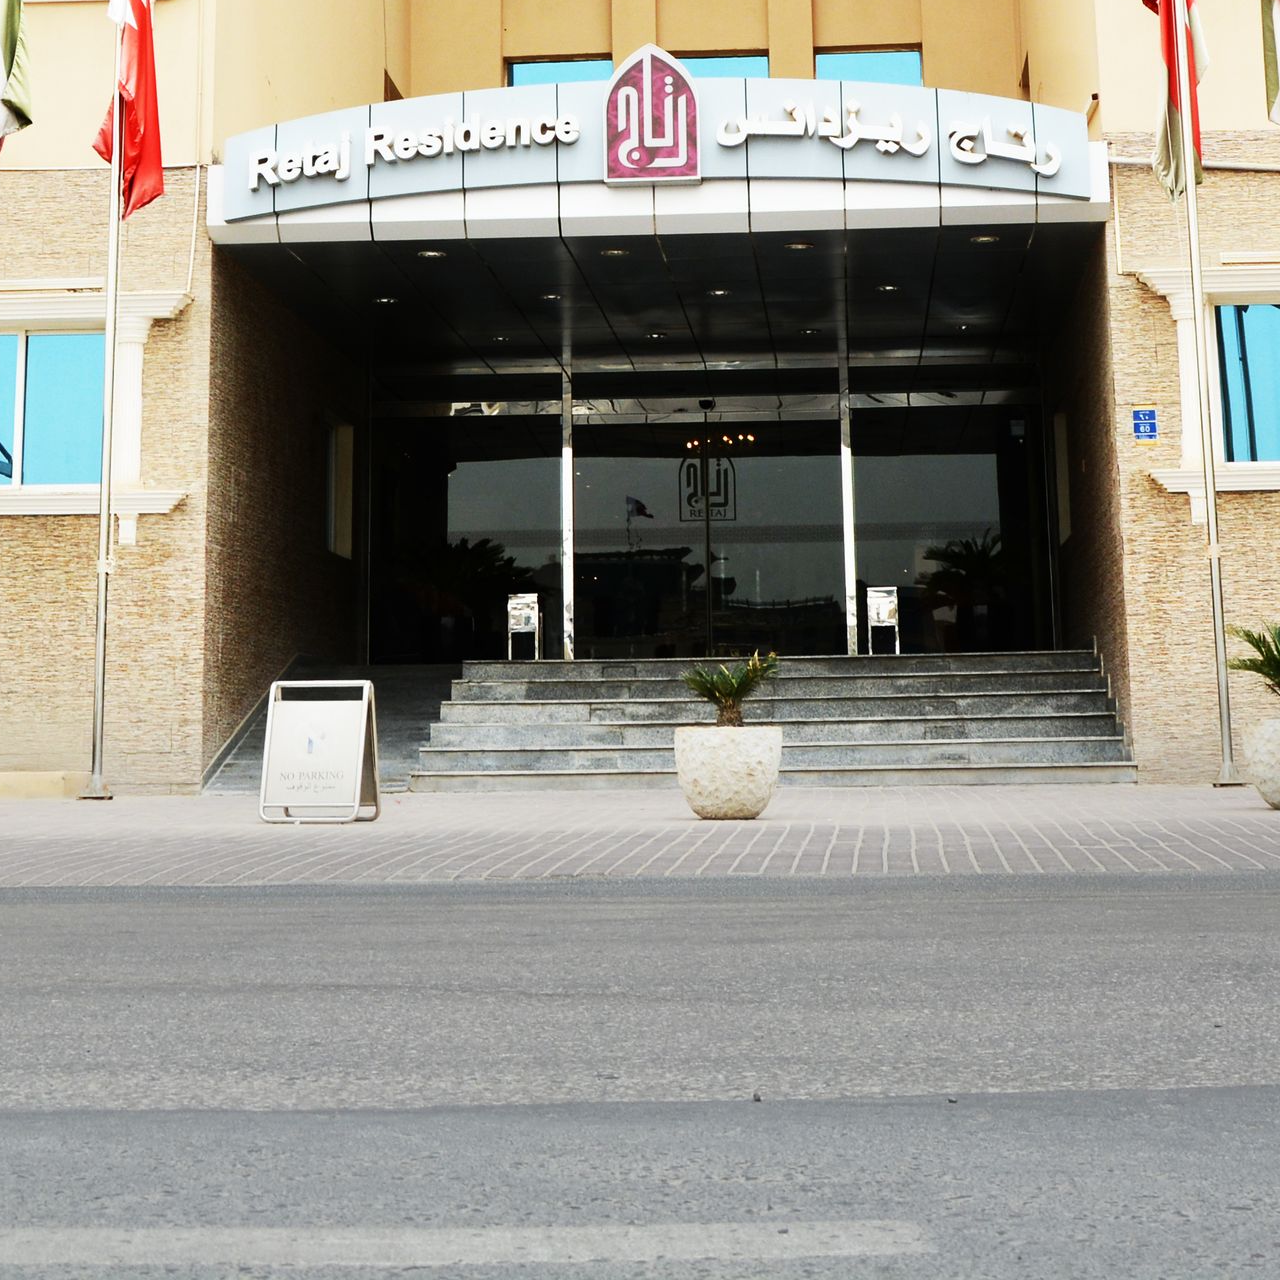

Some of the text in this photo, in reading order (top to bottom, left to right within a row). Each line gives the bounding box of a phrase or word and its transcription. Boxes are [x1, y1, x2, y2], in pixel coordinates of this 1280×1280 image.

[248, 113, 581, 192] Retaj Residence
[948, 115, 1062, 179] رتاج
